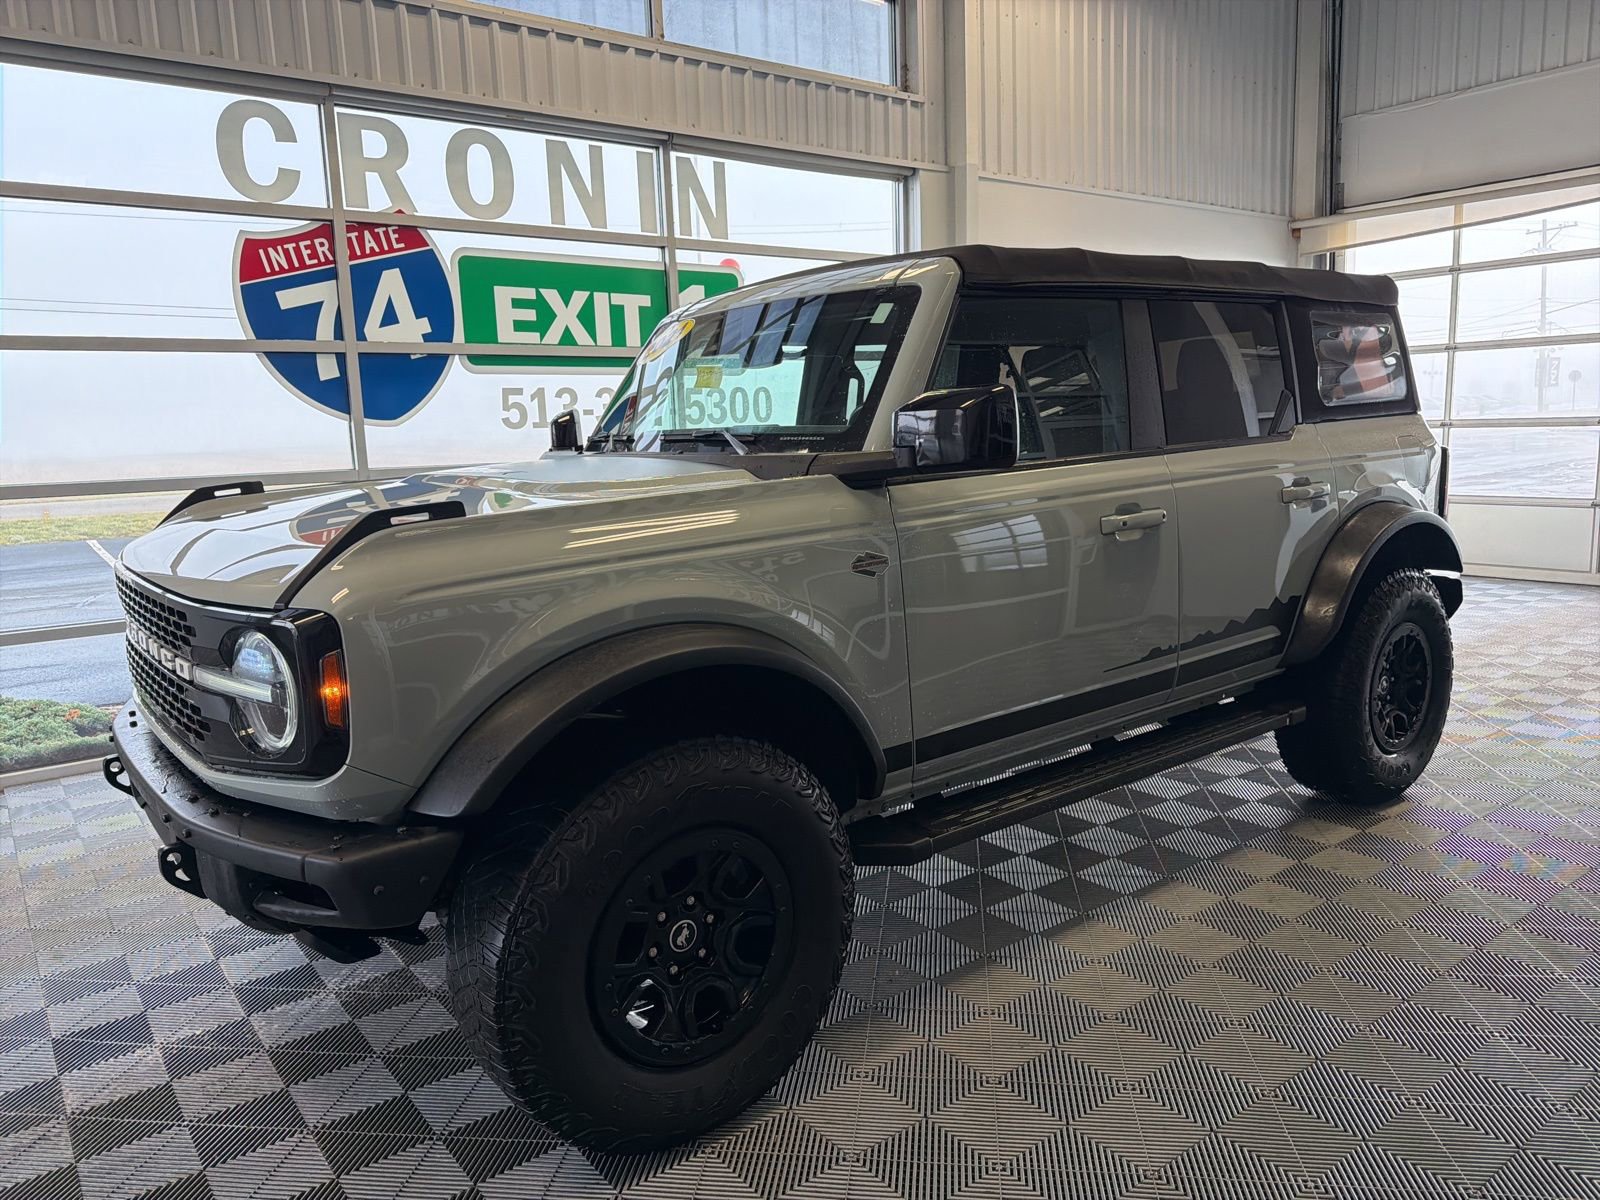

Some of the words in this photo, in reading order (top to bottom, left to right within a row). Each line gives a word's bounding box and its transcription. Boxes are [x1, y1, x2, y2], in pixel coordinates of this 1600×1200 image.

[216, 99, 729, 241] CRONIN
[258, 226, 405, 273] INTERTATE
[275, 267, 432, 382] 74
[493, 285, 652, 347] EXIT
